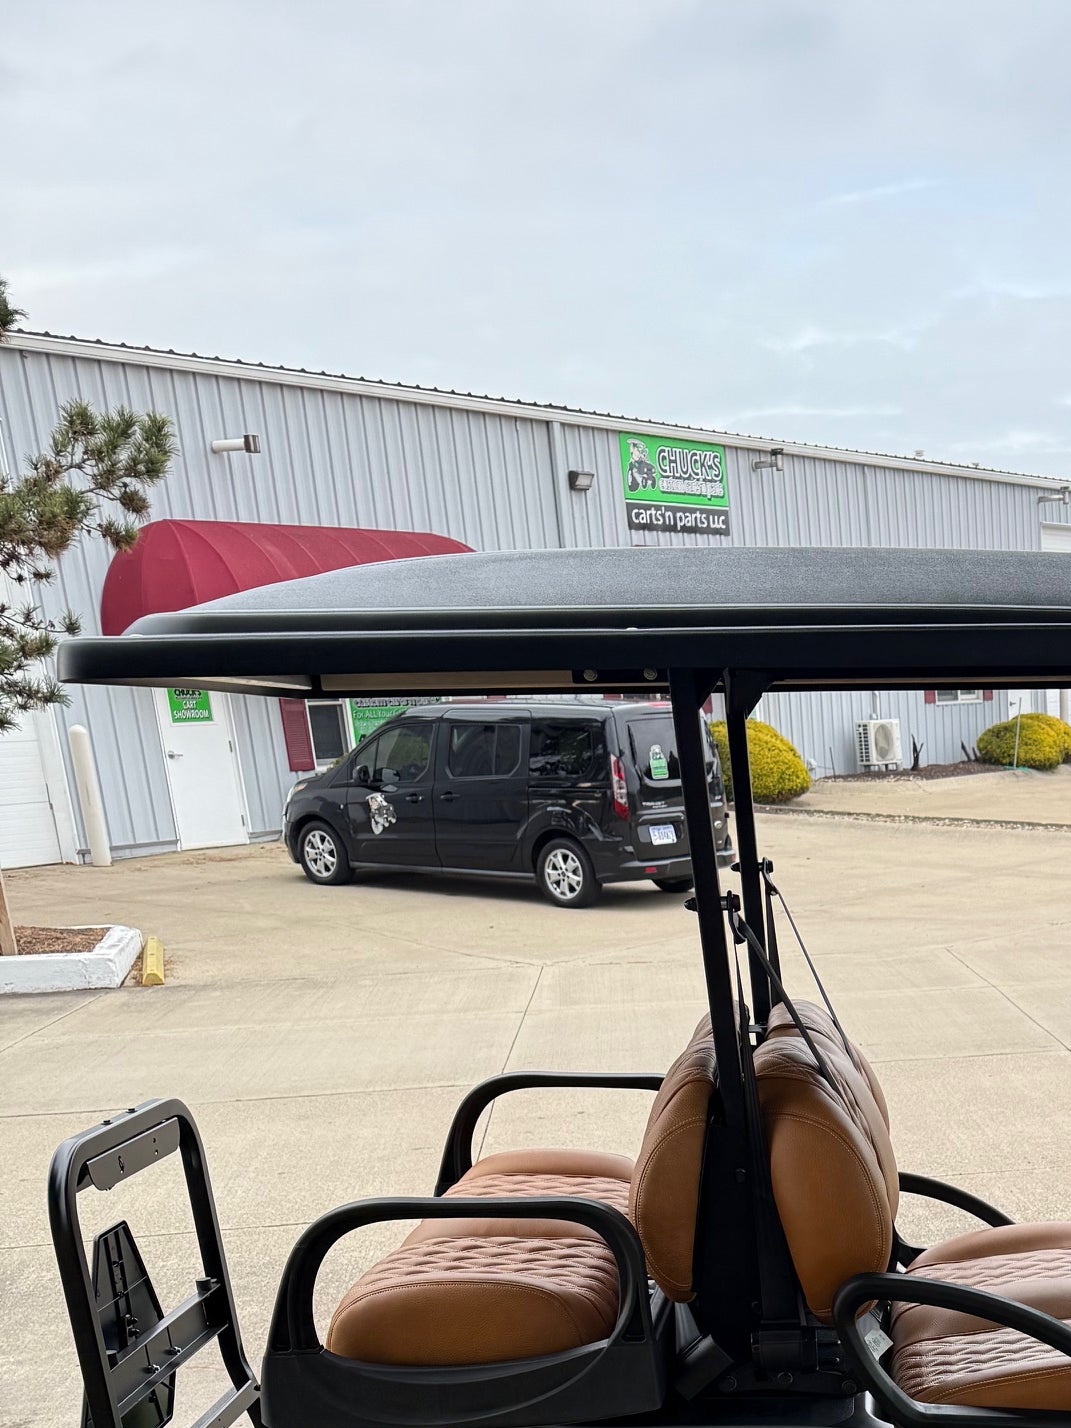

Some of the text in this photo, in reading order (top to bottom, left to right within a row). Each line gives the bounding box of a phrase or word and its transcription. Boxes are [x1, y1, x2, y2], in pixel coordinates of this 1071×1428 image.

[656, 446, 722, 480] CHUCK'S
[631, 506, 673, 526] carts'n
[676, 510, 707, 531] parts
[182, 700, 197, 709] CART
[173, 709, 210, 719] SHOWROOM
